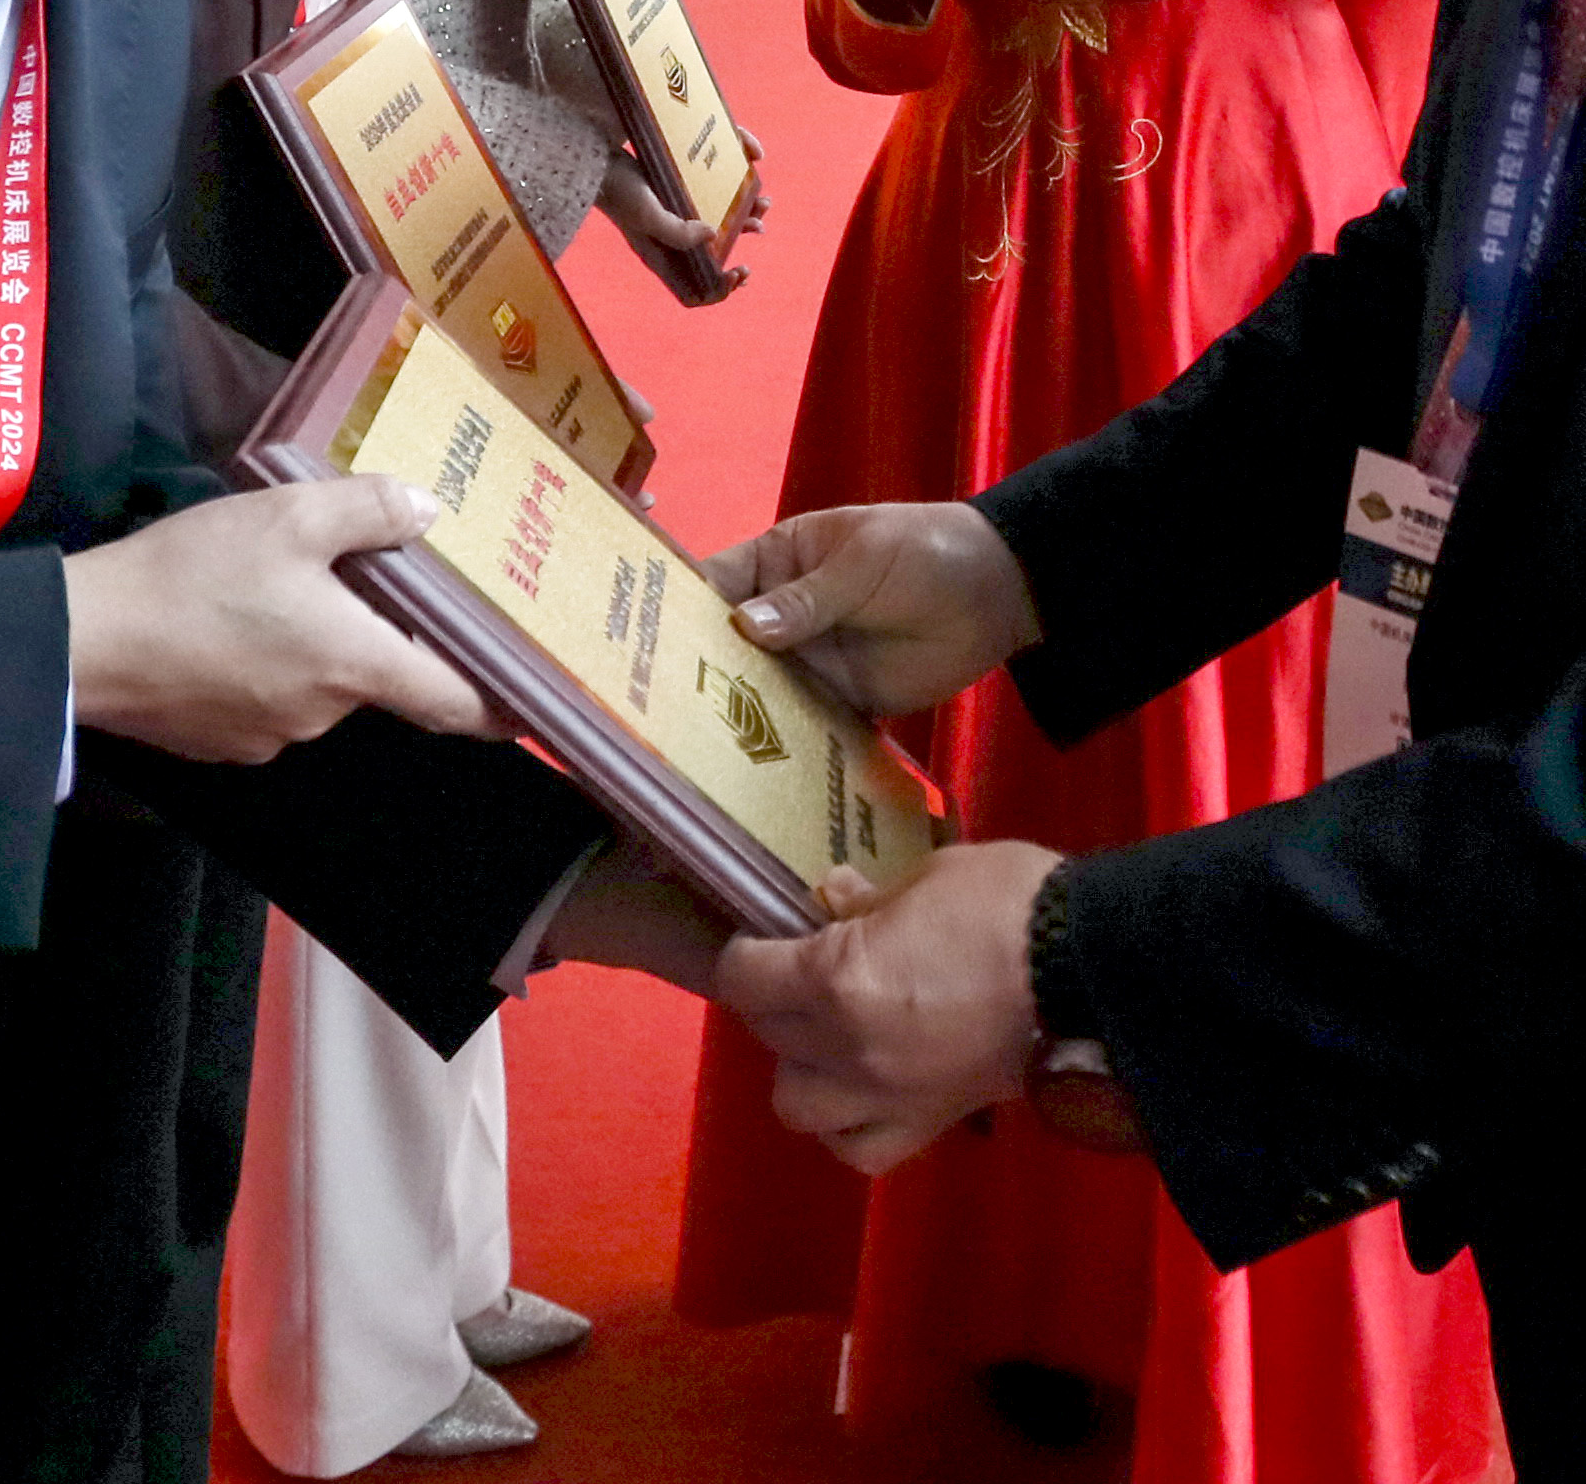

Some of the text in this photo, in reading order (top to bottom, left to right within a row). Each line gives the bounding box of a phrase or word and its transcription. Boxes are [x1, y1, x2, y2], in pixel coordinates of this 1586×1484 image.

[383, 132, 463, 223] 自主创新十佳
[0, 45, 38, 472] 中国数控机床展览会 CCMT 2024
[503, 459, 568, 602] 自主创新十佳
